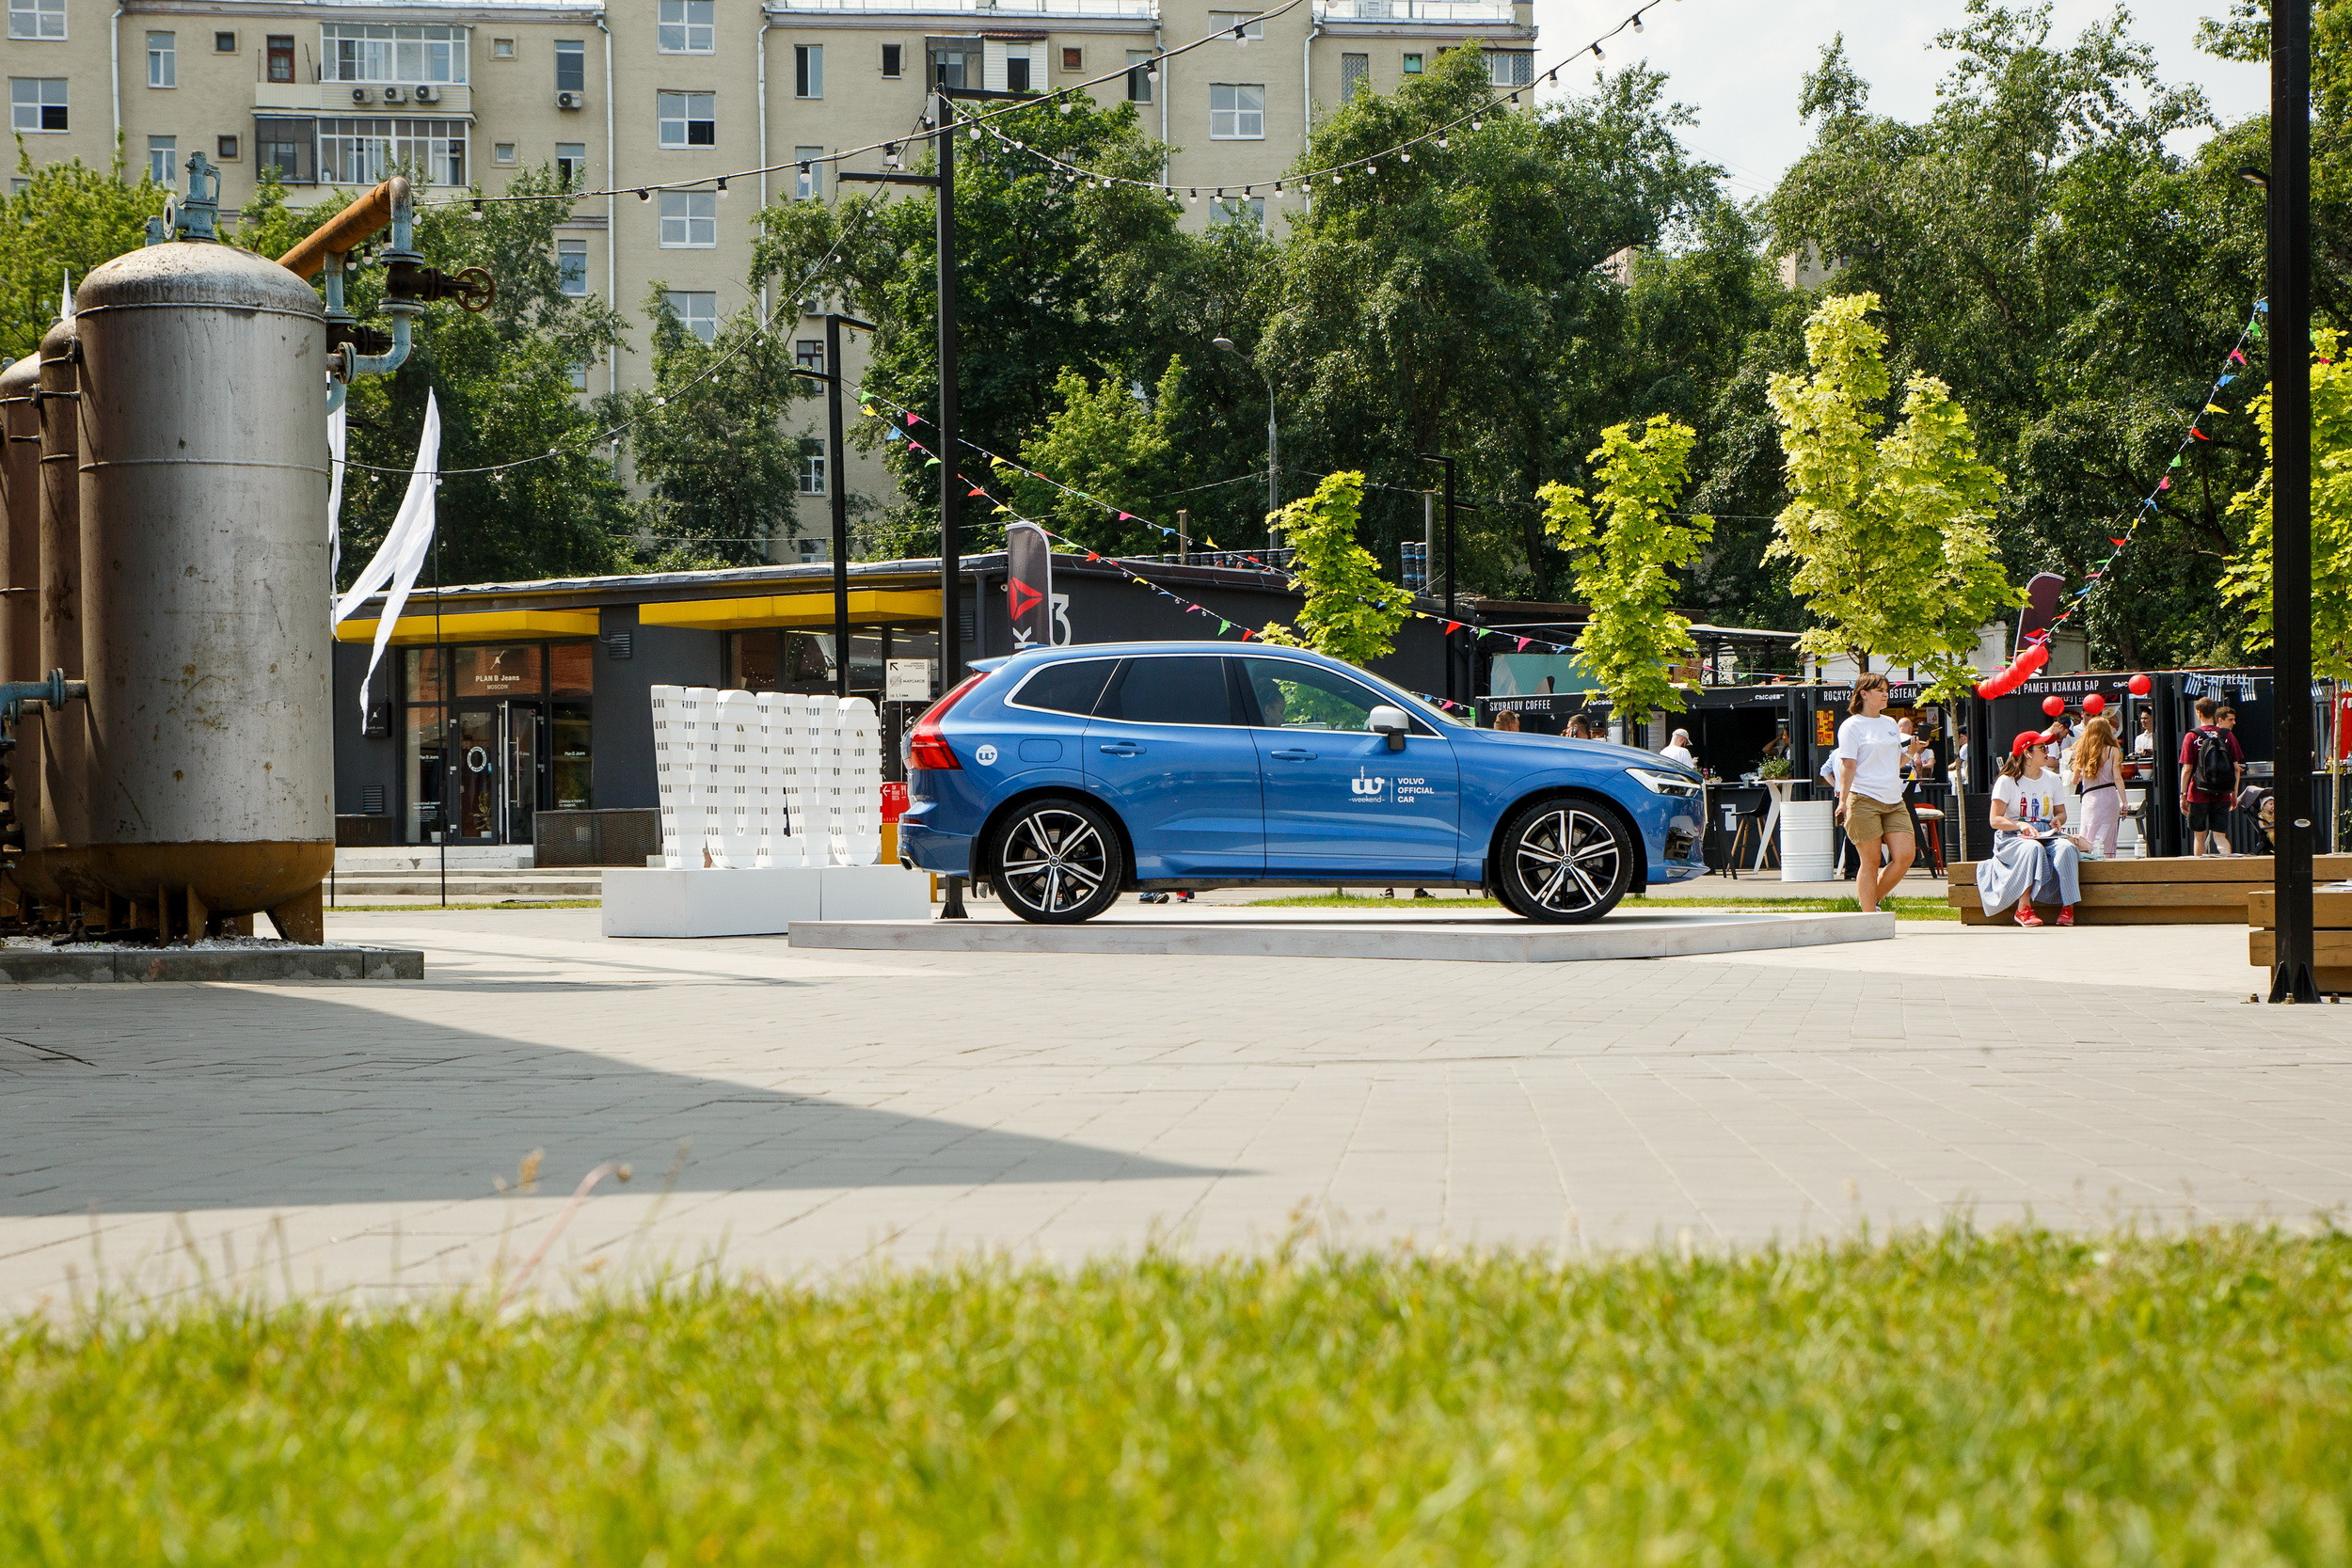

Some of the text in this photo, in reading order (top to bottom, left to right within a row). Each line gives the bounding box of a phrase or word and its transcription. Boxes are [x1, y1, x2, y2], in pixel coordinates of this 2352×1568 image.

[2024, 683, 2049, 693] РАМЕН
[2052, 681, 2081, 692] ИЗАКАЯ
[2084, 680, 2099, 690] БАР
[1489, 700, 1550, 711] SKURATOV COFFEE
